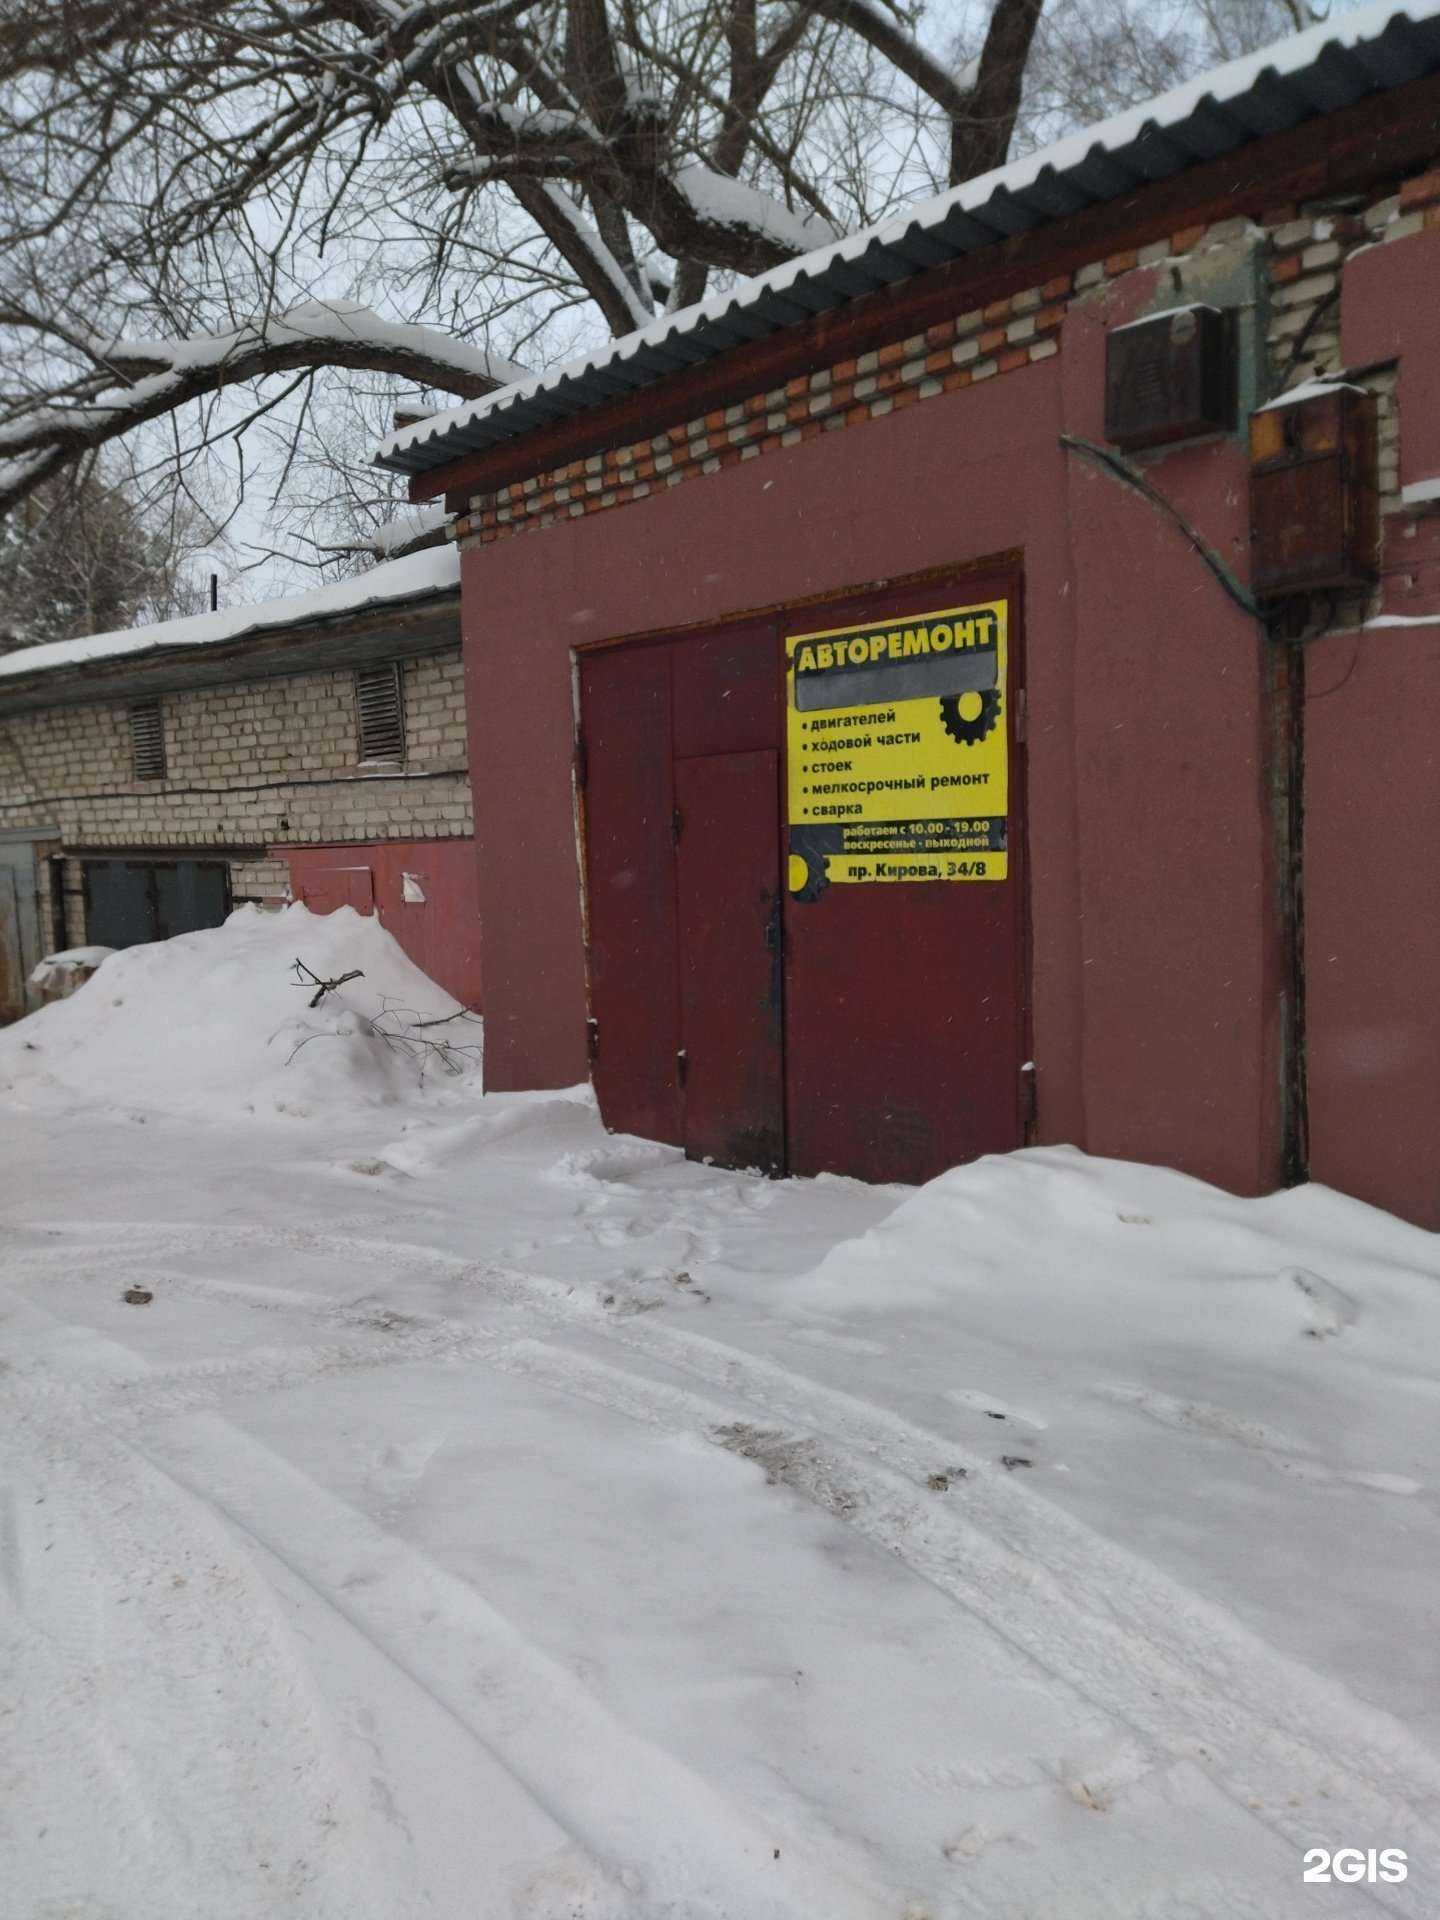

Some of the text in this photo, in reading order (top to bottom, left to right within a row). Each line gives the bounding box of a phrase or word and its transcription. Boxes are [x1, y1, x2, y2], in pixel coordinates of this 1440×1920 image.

[798, 617, 993, 672] АВТОРЕМОНТ
[811, 709, 896, 732] двигателей
[811, 731, 921, 752] ходовой части
[811, 760, 852, 773] стоек
[812, 773, 990, 795] мелкосрочный ремонт
[812, 803, 863, 818] сварка
[843, 824, 898, 839] работаем
[909, 822, 944, 835] 10.00
[954, 820, 990, 833] 19.00
[843, 838, 916, 852] воскресенье
[925, 834, 989, 849] выходной
[848, 861, 987, 882] пр. Кирова, 34/8
